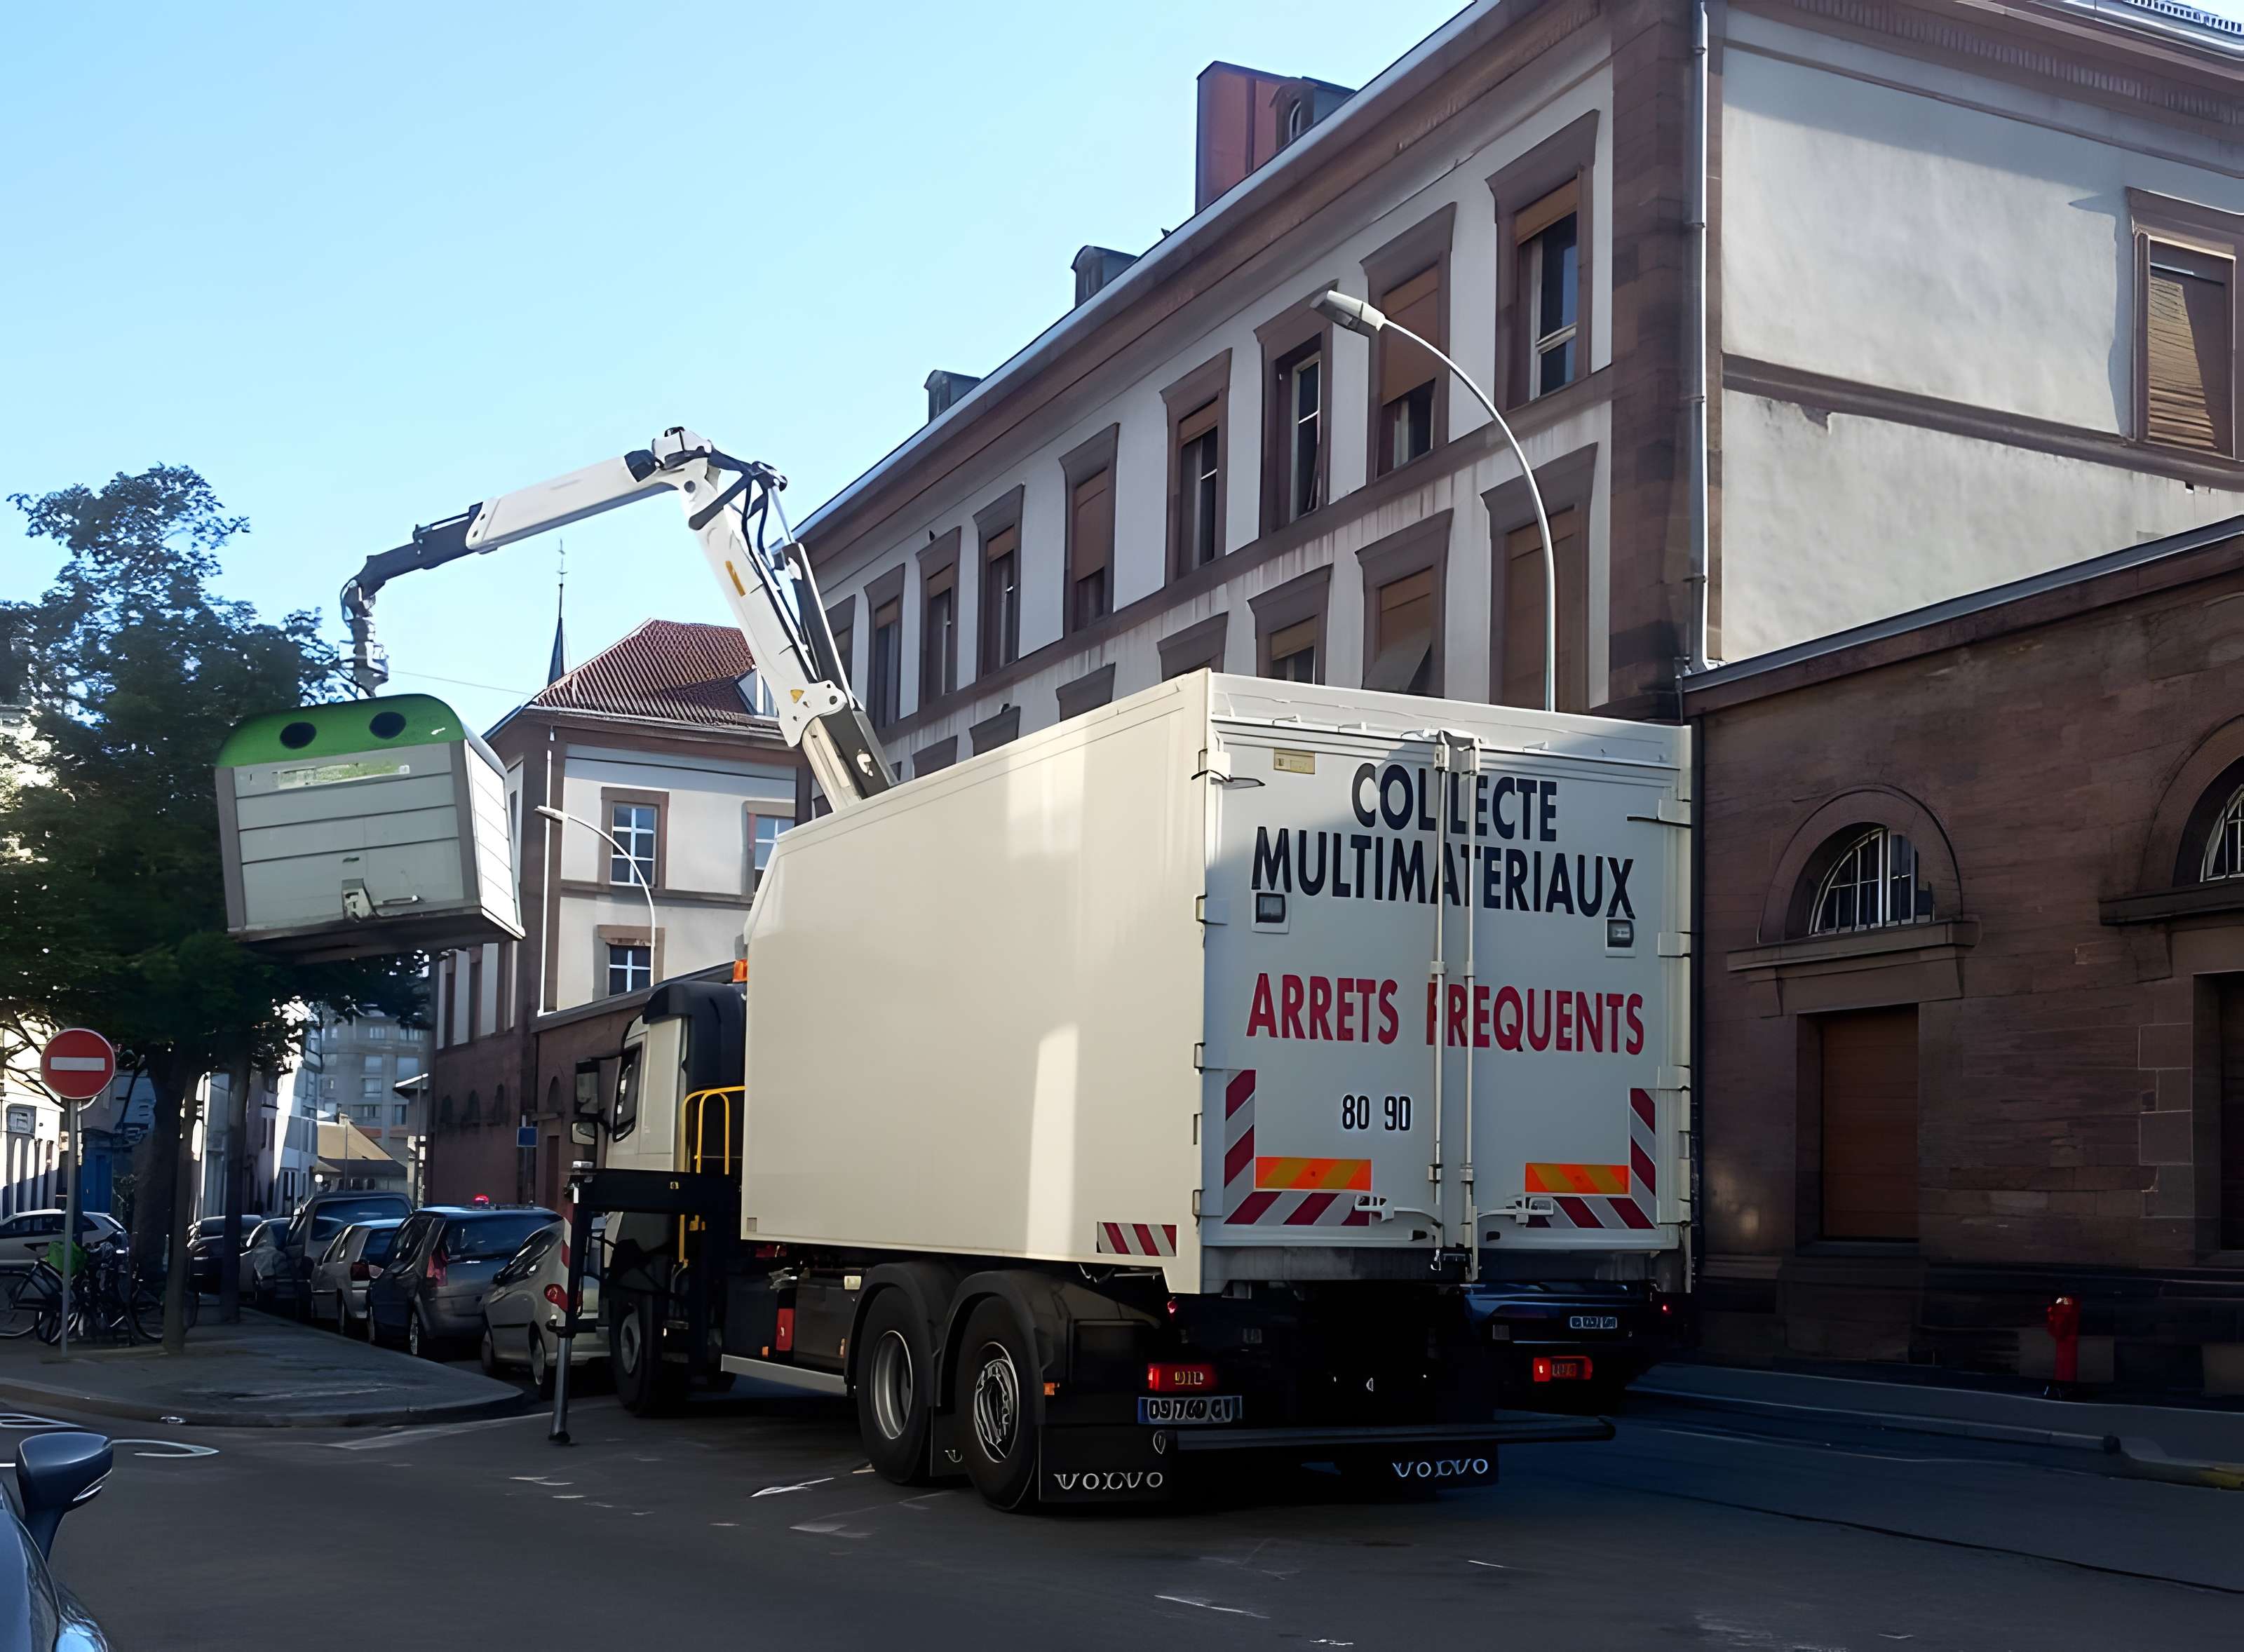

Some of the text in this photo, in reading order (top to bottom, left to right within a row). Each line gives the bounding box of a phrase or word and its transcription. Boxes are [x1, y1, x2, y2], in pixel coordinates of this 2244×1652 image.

[1351, 762, 1557, 842] COLLECTE
[1251, 825, 1636, 920] MULTIMATERIAUX
[1245, 973, 1399, 1045] ARRETS
[1341, 1094, 1412, 1131] 80 90
[1053, 1472, 1163, 1491] VOLVO
[1393, 1458, 1489, 1478] VOLVO
